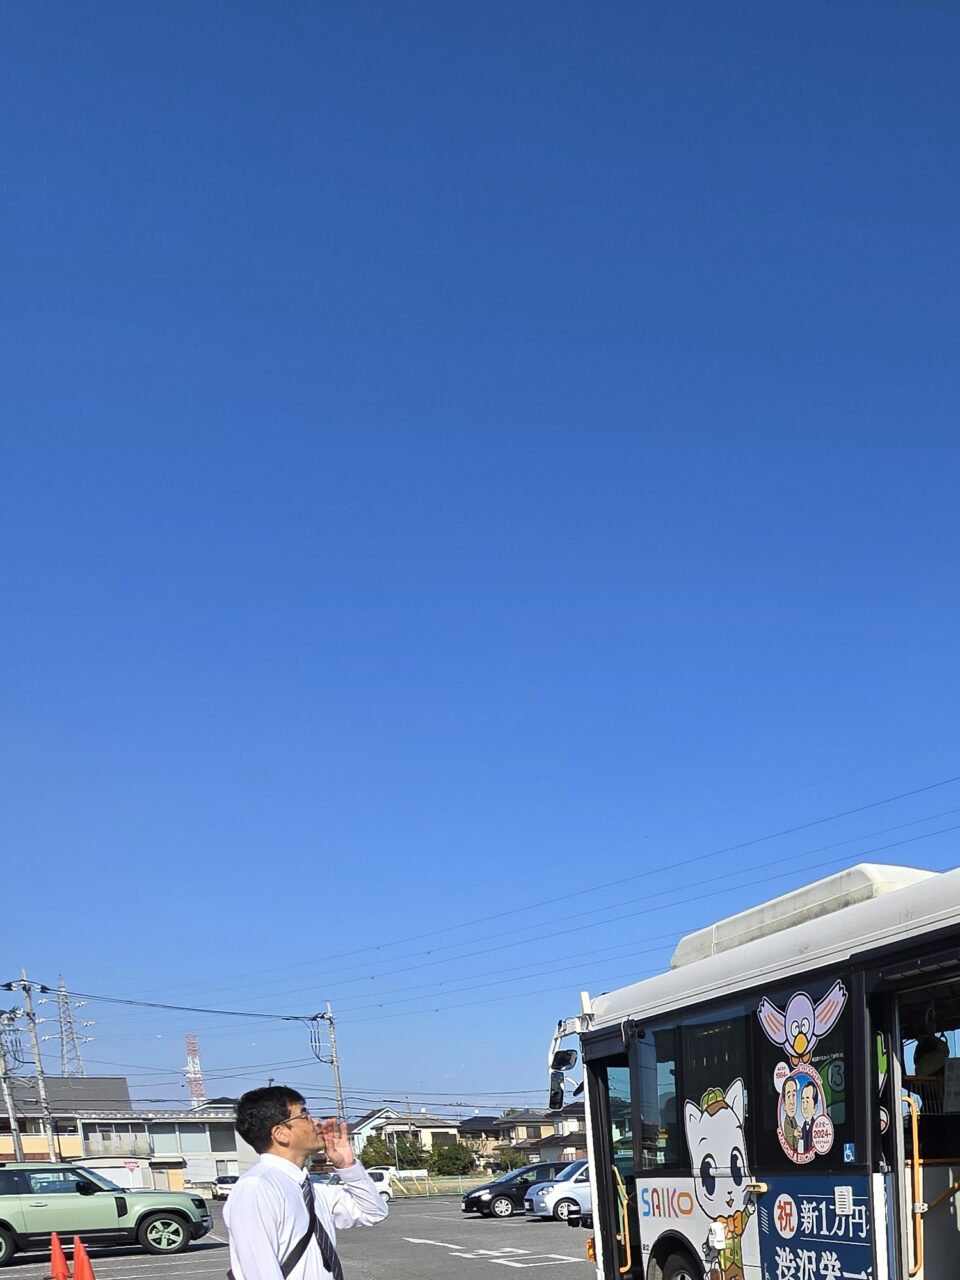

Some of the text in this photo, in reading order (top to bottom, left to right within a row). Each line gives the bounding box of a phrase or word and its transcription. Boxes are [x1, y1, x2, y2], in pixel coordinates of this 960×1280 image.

[641, 1187, 694, 1218] SAIKO
[777, 1200, 795, 1232] 祝
[800, 1200, 870, 1239] 新1万円
